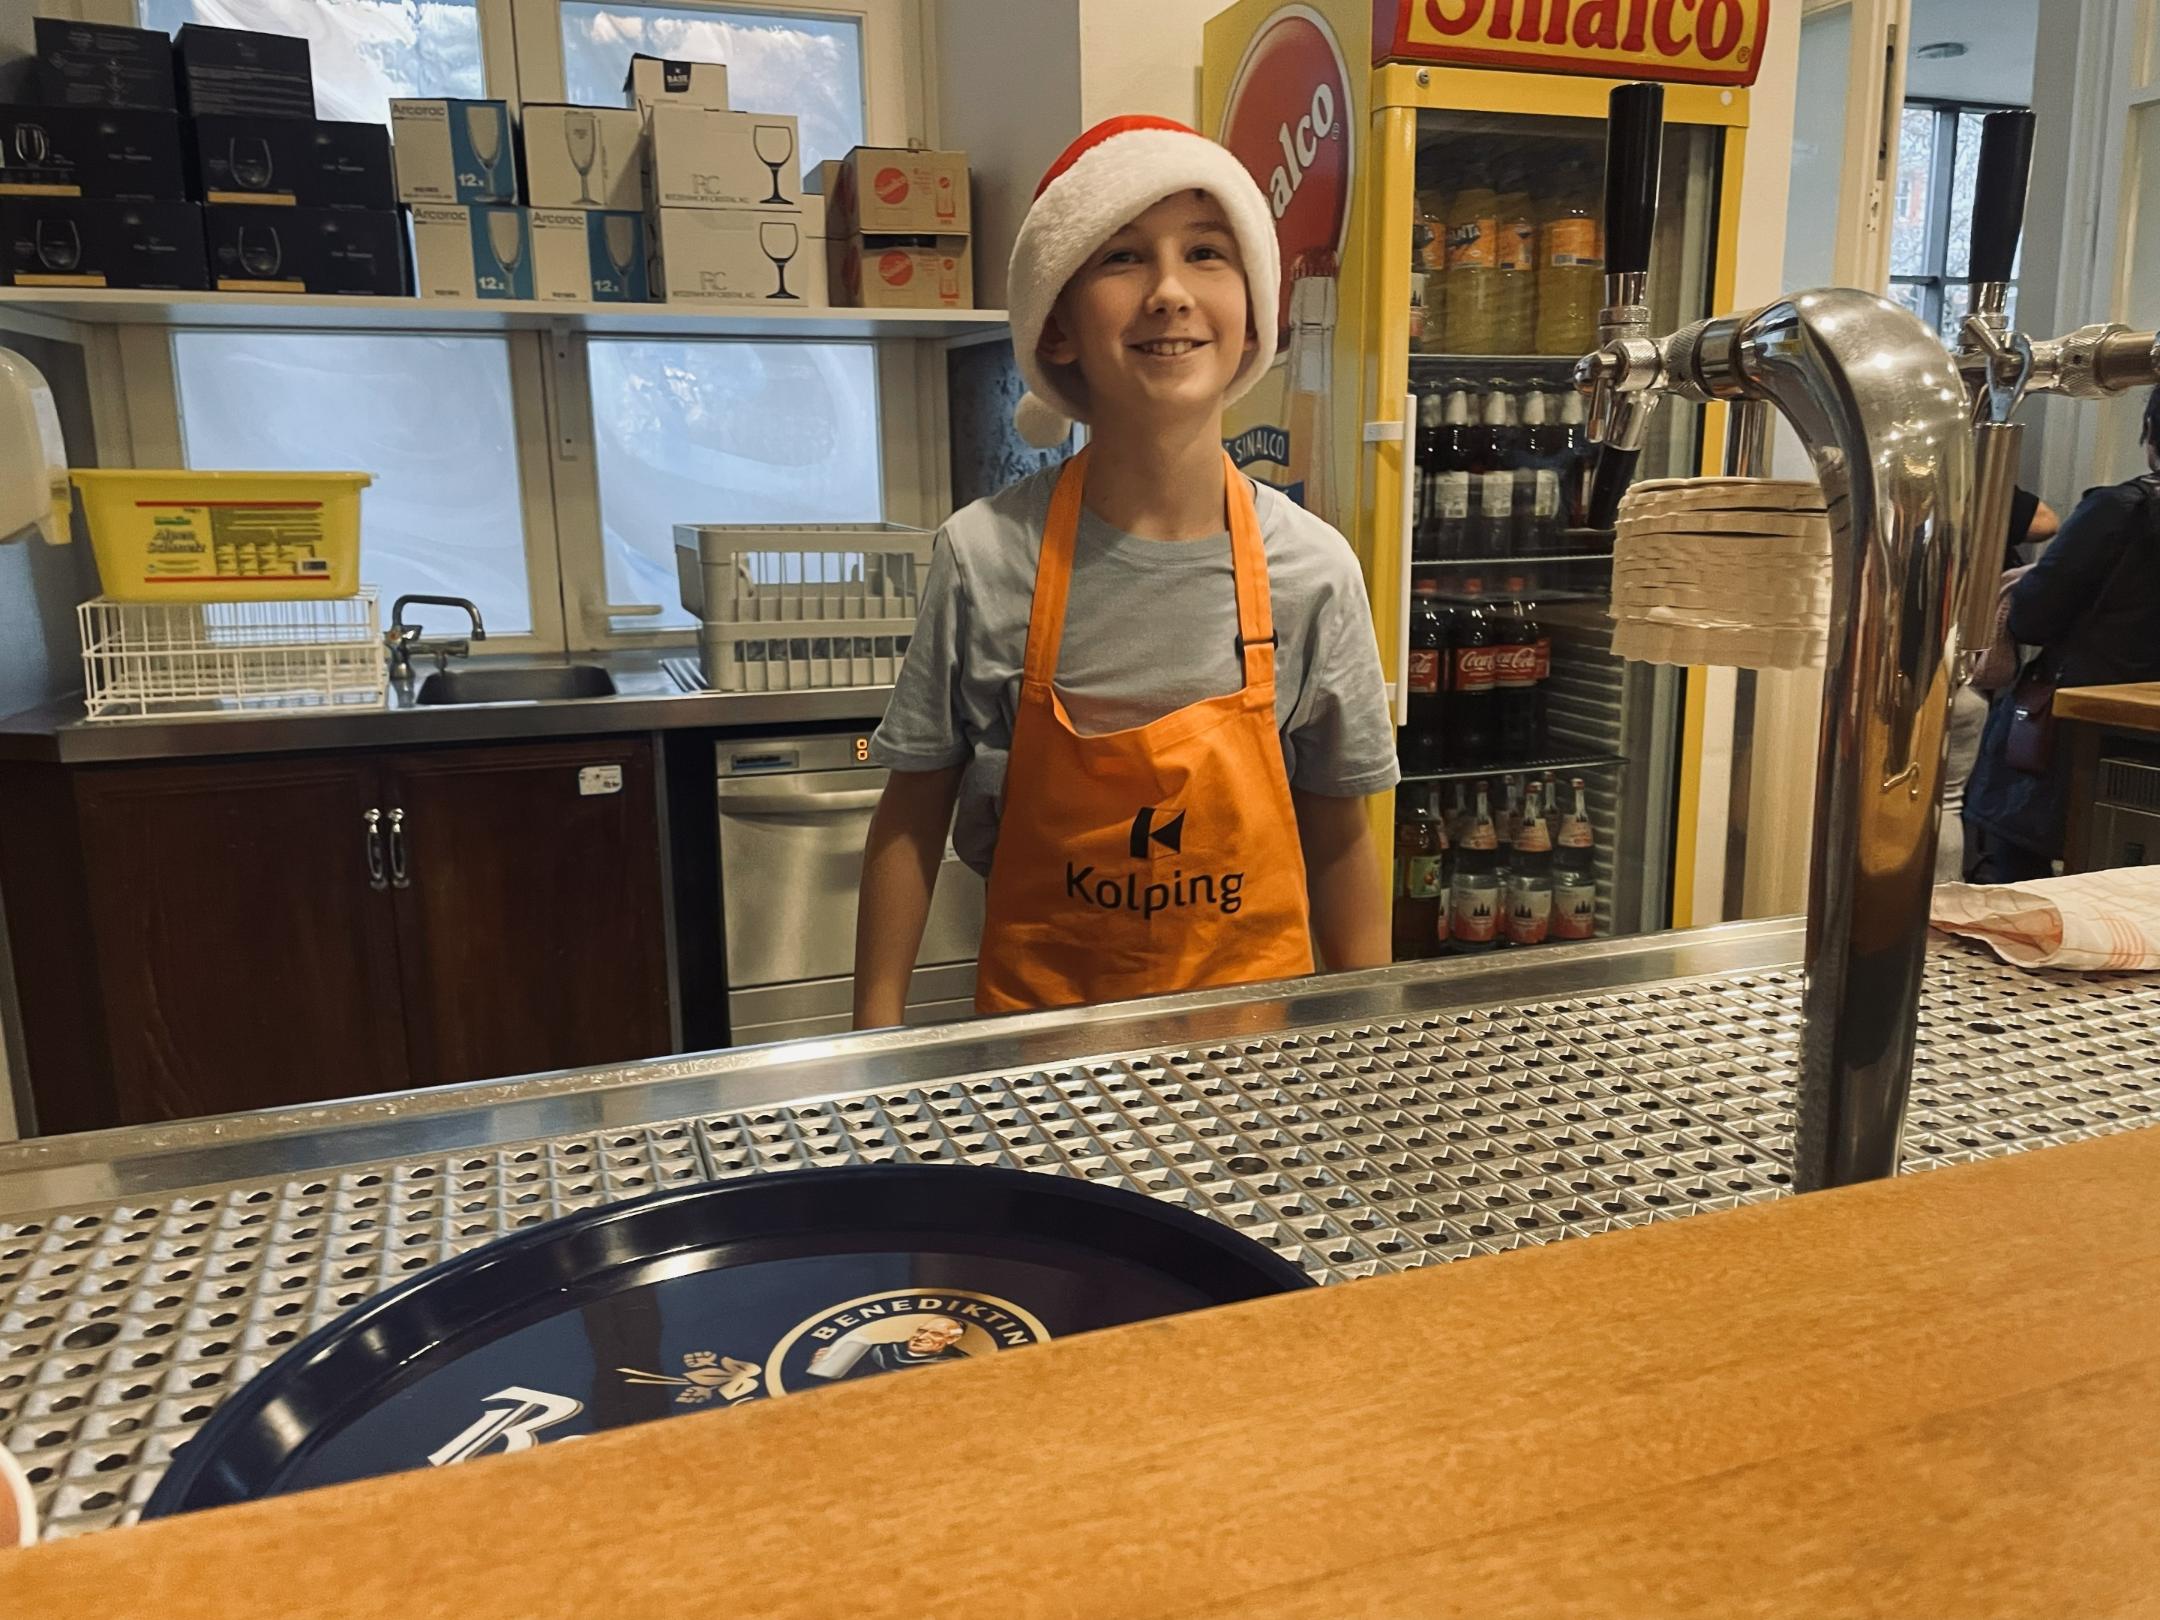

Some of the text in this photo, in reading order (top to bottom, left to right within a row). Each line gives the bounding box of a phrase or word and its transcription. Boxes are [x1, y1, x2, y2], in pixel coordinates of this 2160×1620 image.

[392, 103, 446, 117] Arcoroc
[414, 207, 468, 221] Arcoroc
[533, 210, 585, 225] Arcoroc
[1065, 861, 1245, 921] Kolping
